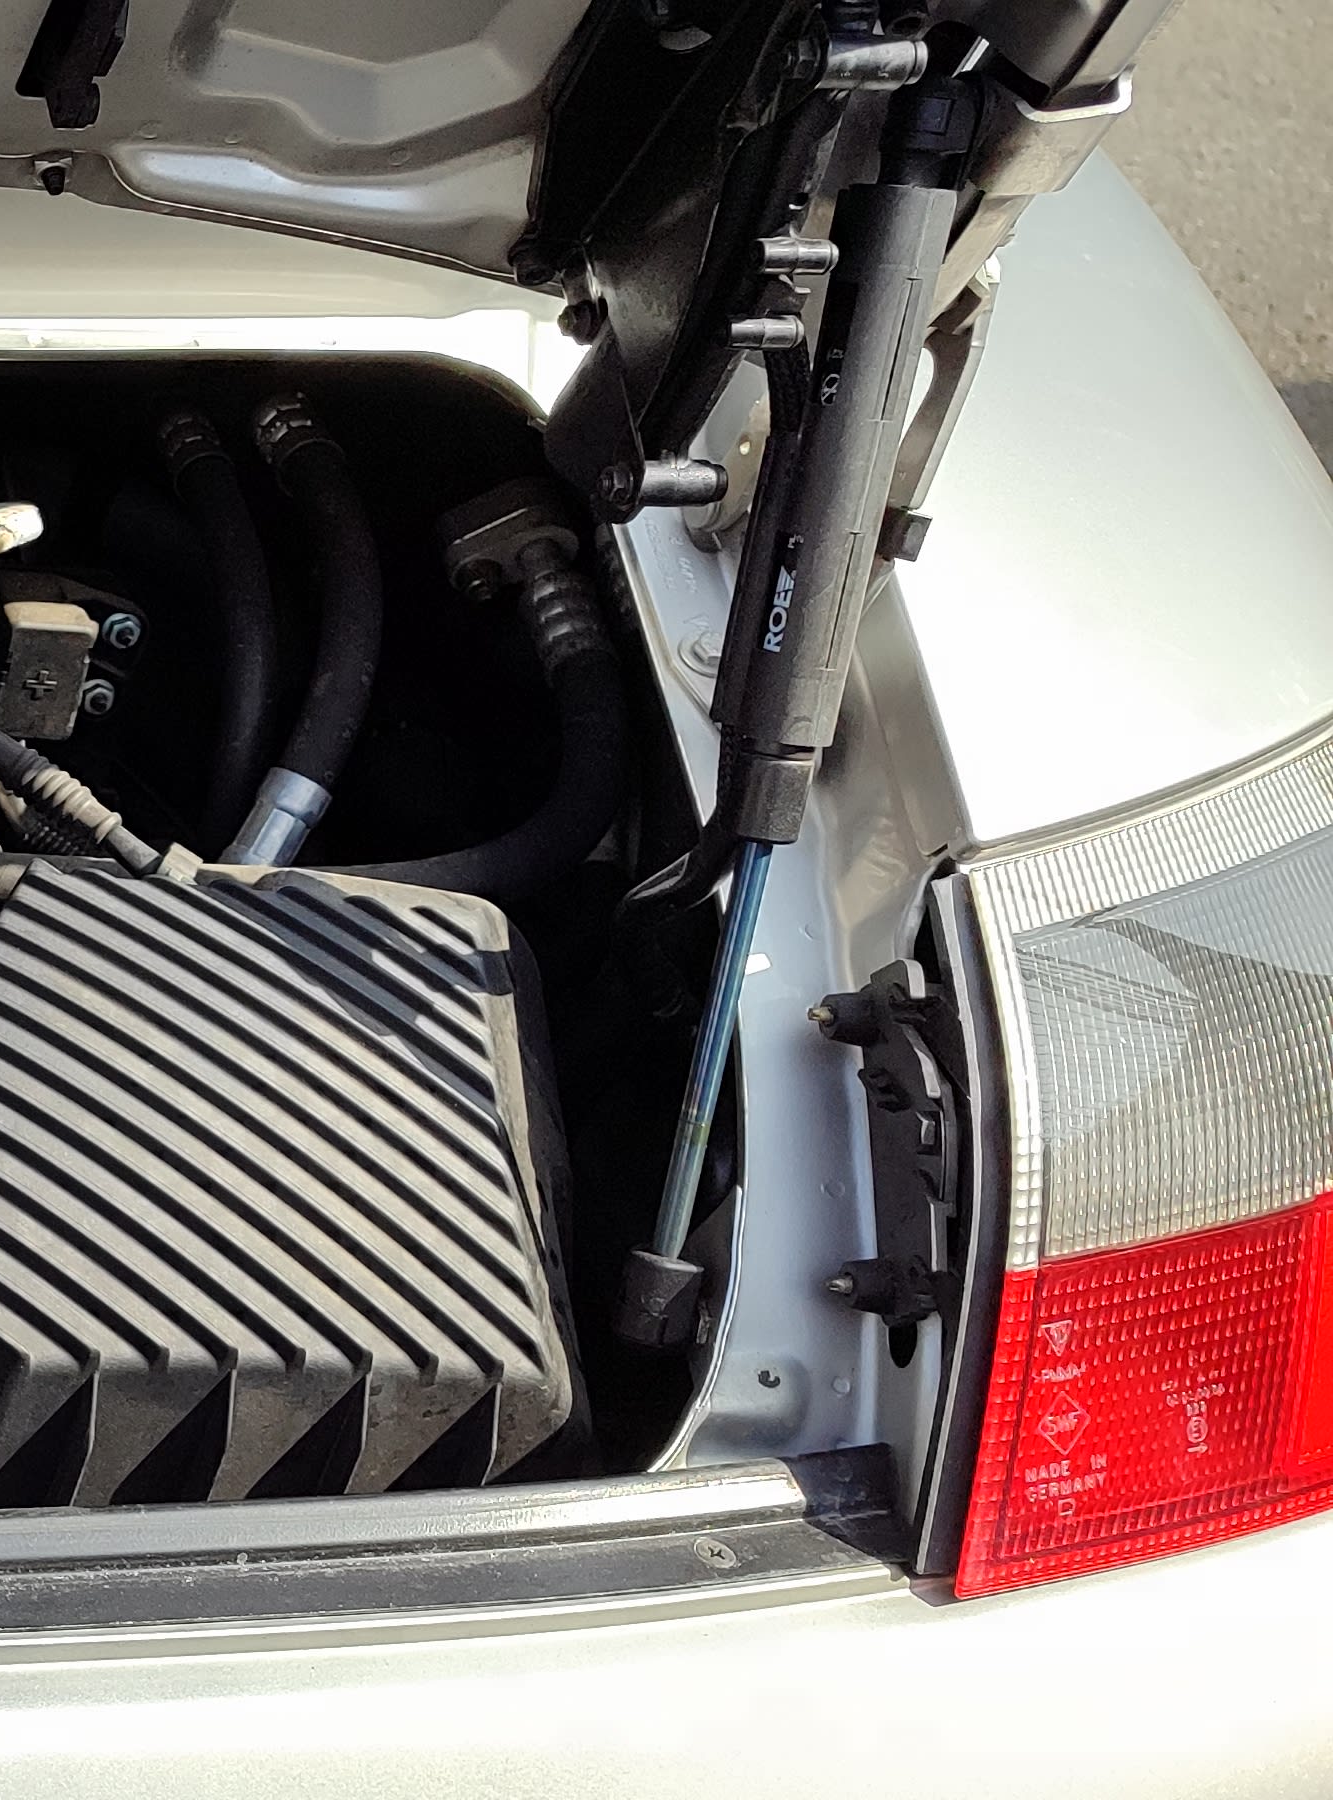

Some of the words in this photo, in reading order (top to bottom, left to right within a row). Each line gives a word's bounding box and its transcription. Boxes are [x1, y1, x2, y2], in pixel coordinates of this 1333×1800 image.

[1046, 1411, 1081, 1436] SWF
[1024, 1459, 1071, 1483] MADE
[1090, 1453, 1108, 1470] IN
[1025, 1471, 1108, 1503] GERMANY
